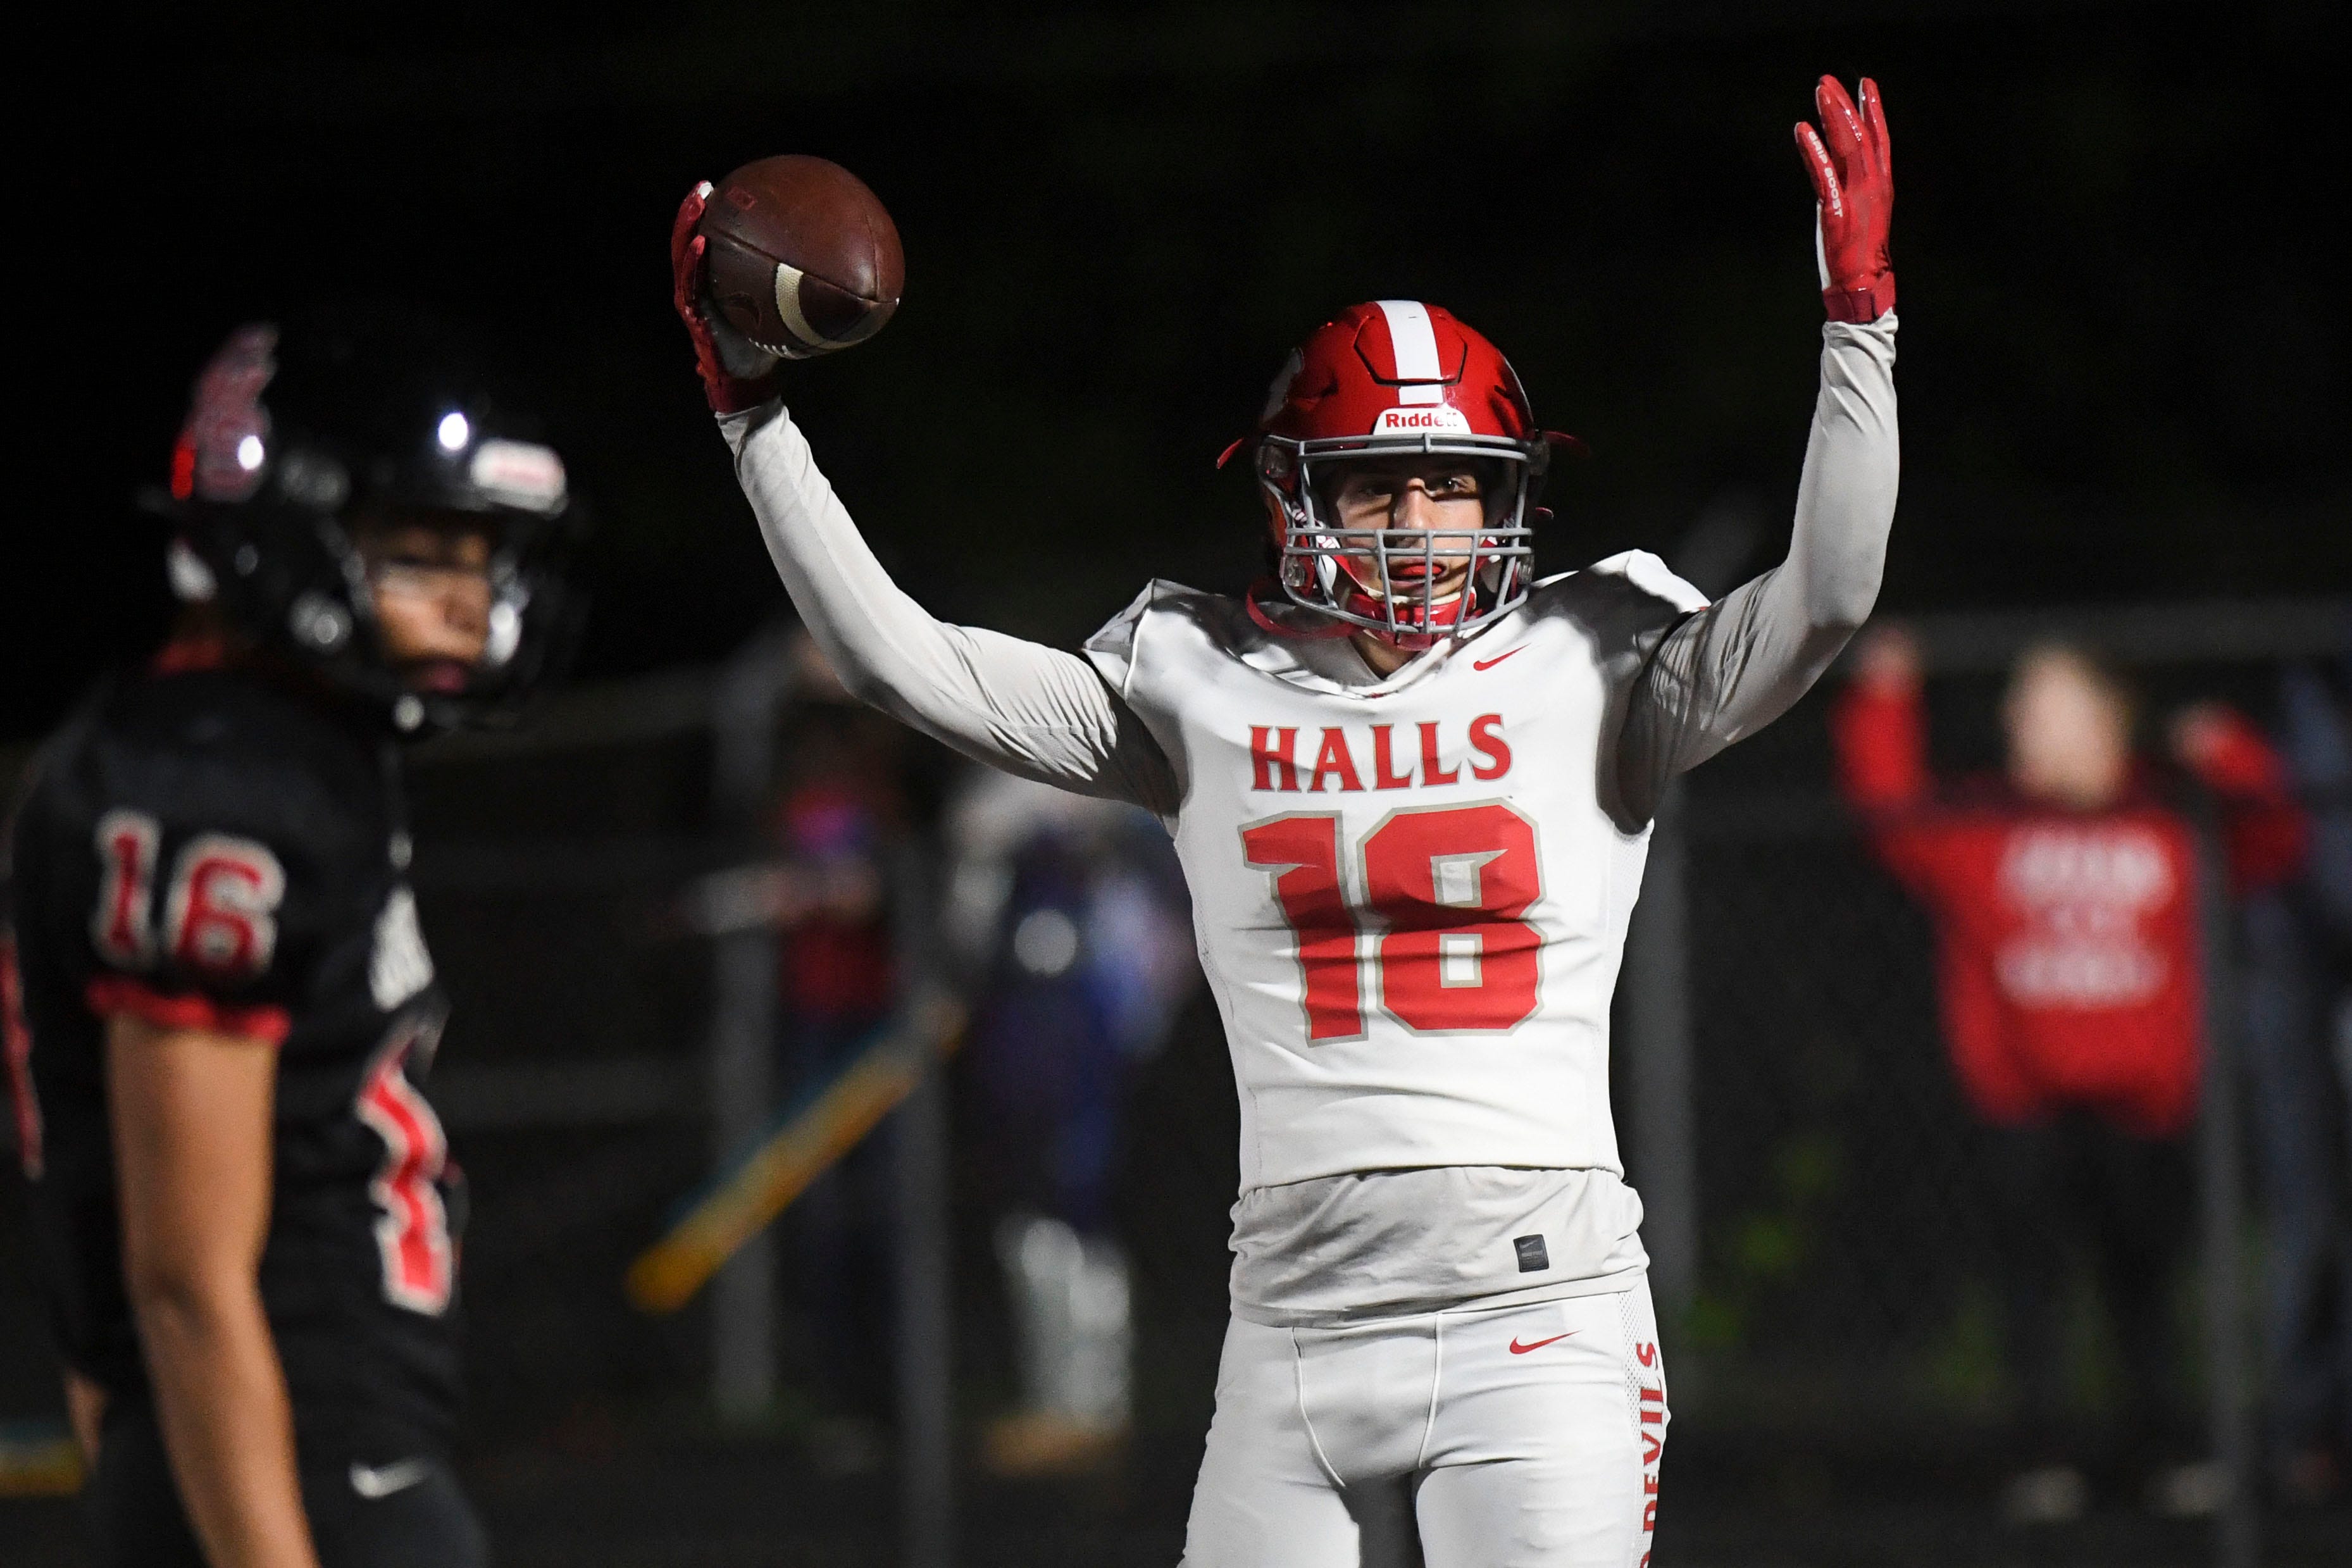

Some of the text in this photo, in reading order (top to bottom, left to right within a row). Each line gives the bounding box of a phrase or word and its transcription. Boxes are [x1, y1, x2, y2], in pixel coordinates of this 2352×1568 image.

[1248, 712, 1513, 793] HALLS
[92, 809, 287, 976] 16
[1237, 797, 1548, 1048] 18
[1636, 1342, 1664, 1534] DEVILS
